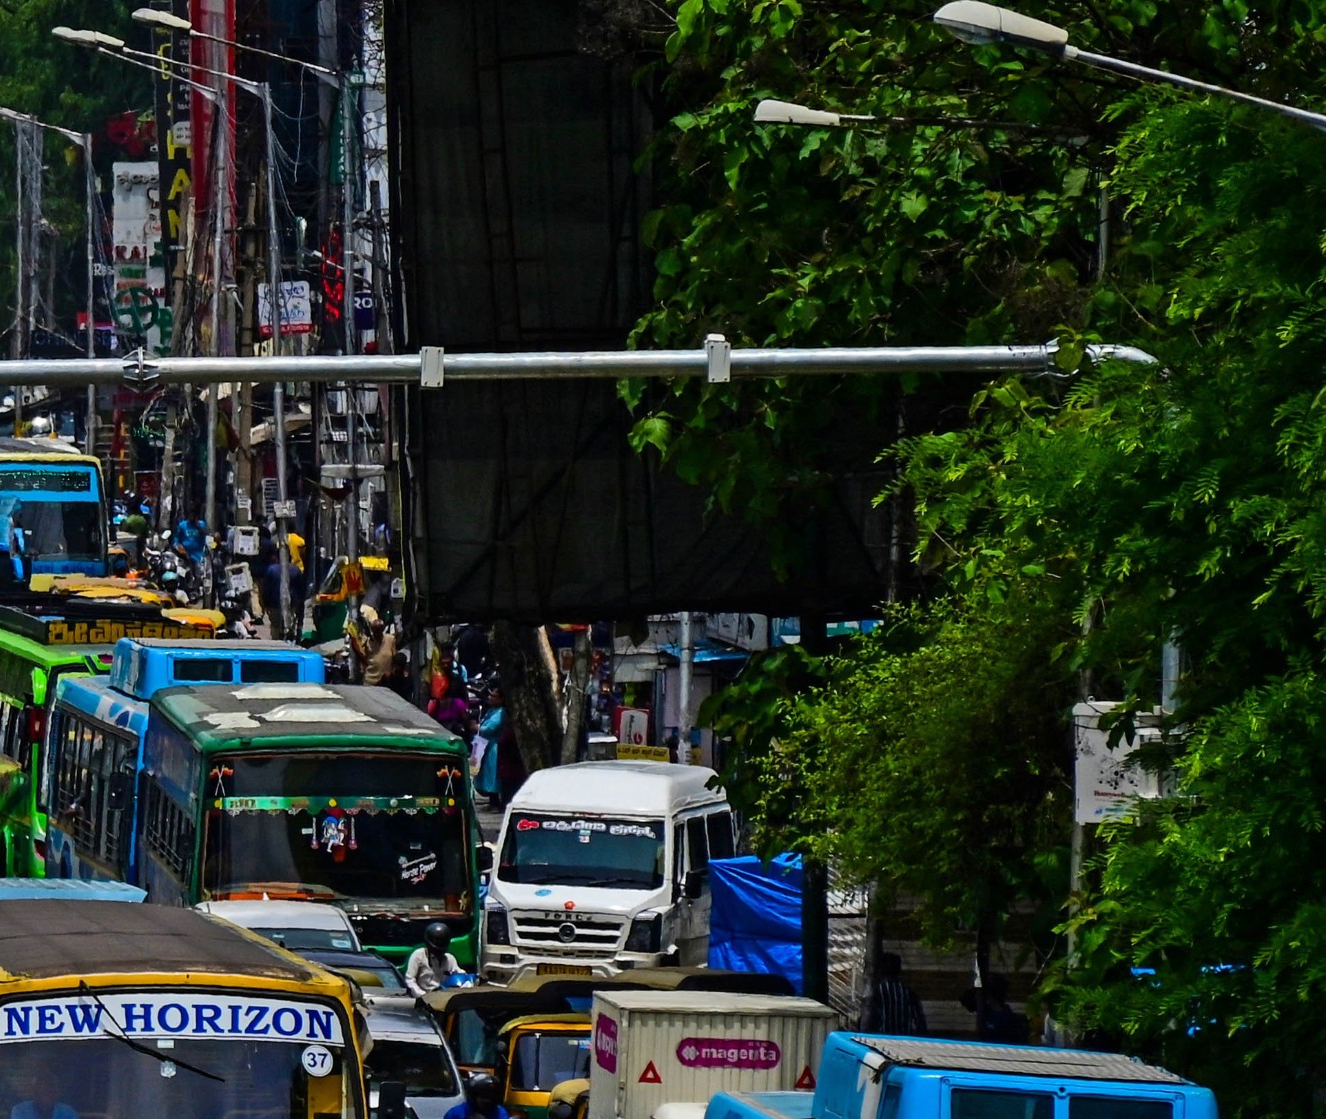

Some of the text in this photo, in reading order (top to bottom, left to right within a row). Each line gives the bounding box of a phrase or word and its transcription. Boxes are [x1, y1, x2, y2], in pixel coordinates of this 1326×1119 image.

[3, 1003, 335, 1040] NEW HORIZON
[307, 1052, 329, 1069] 37
[700, 1047, 777, 1063] magenta
